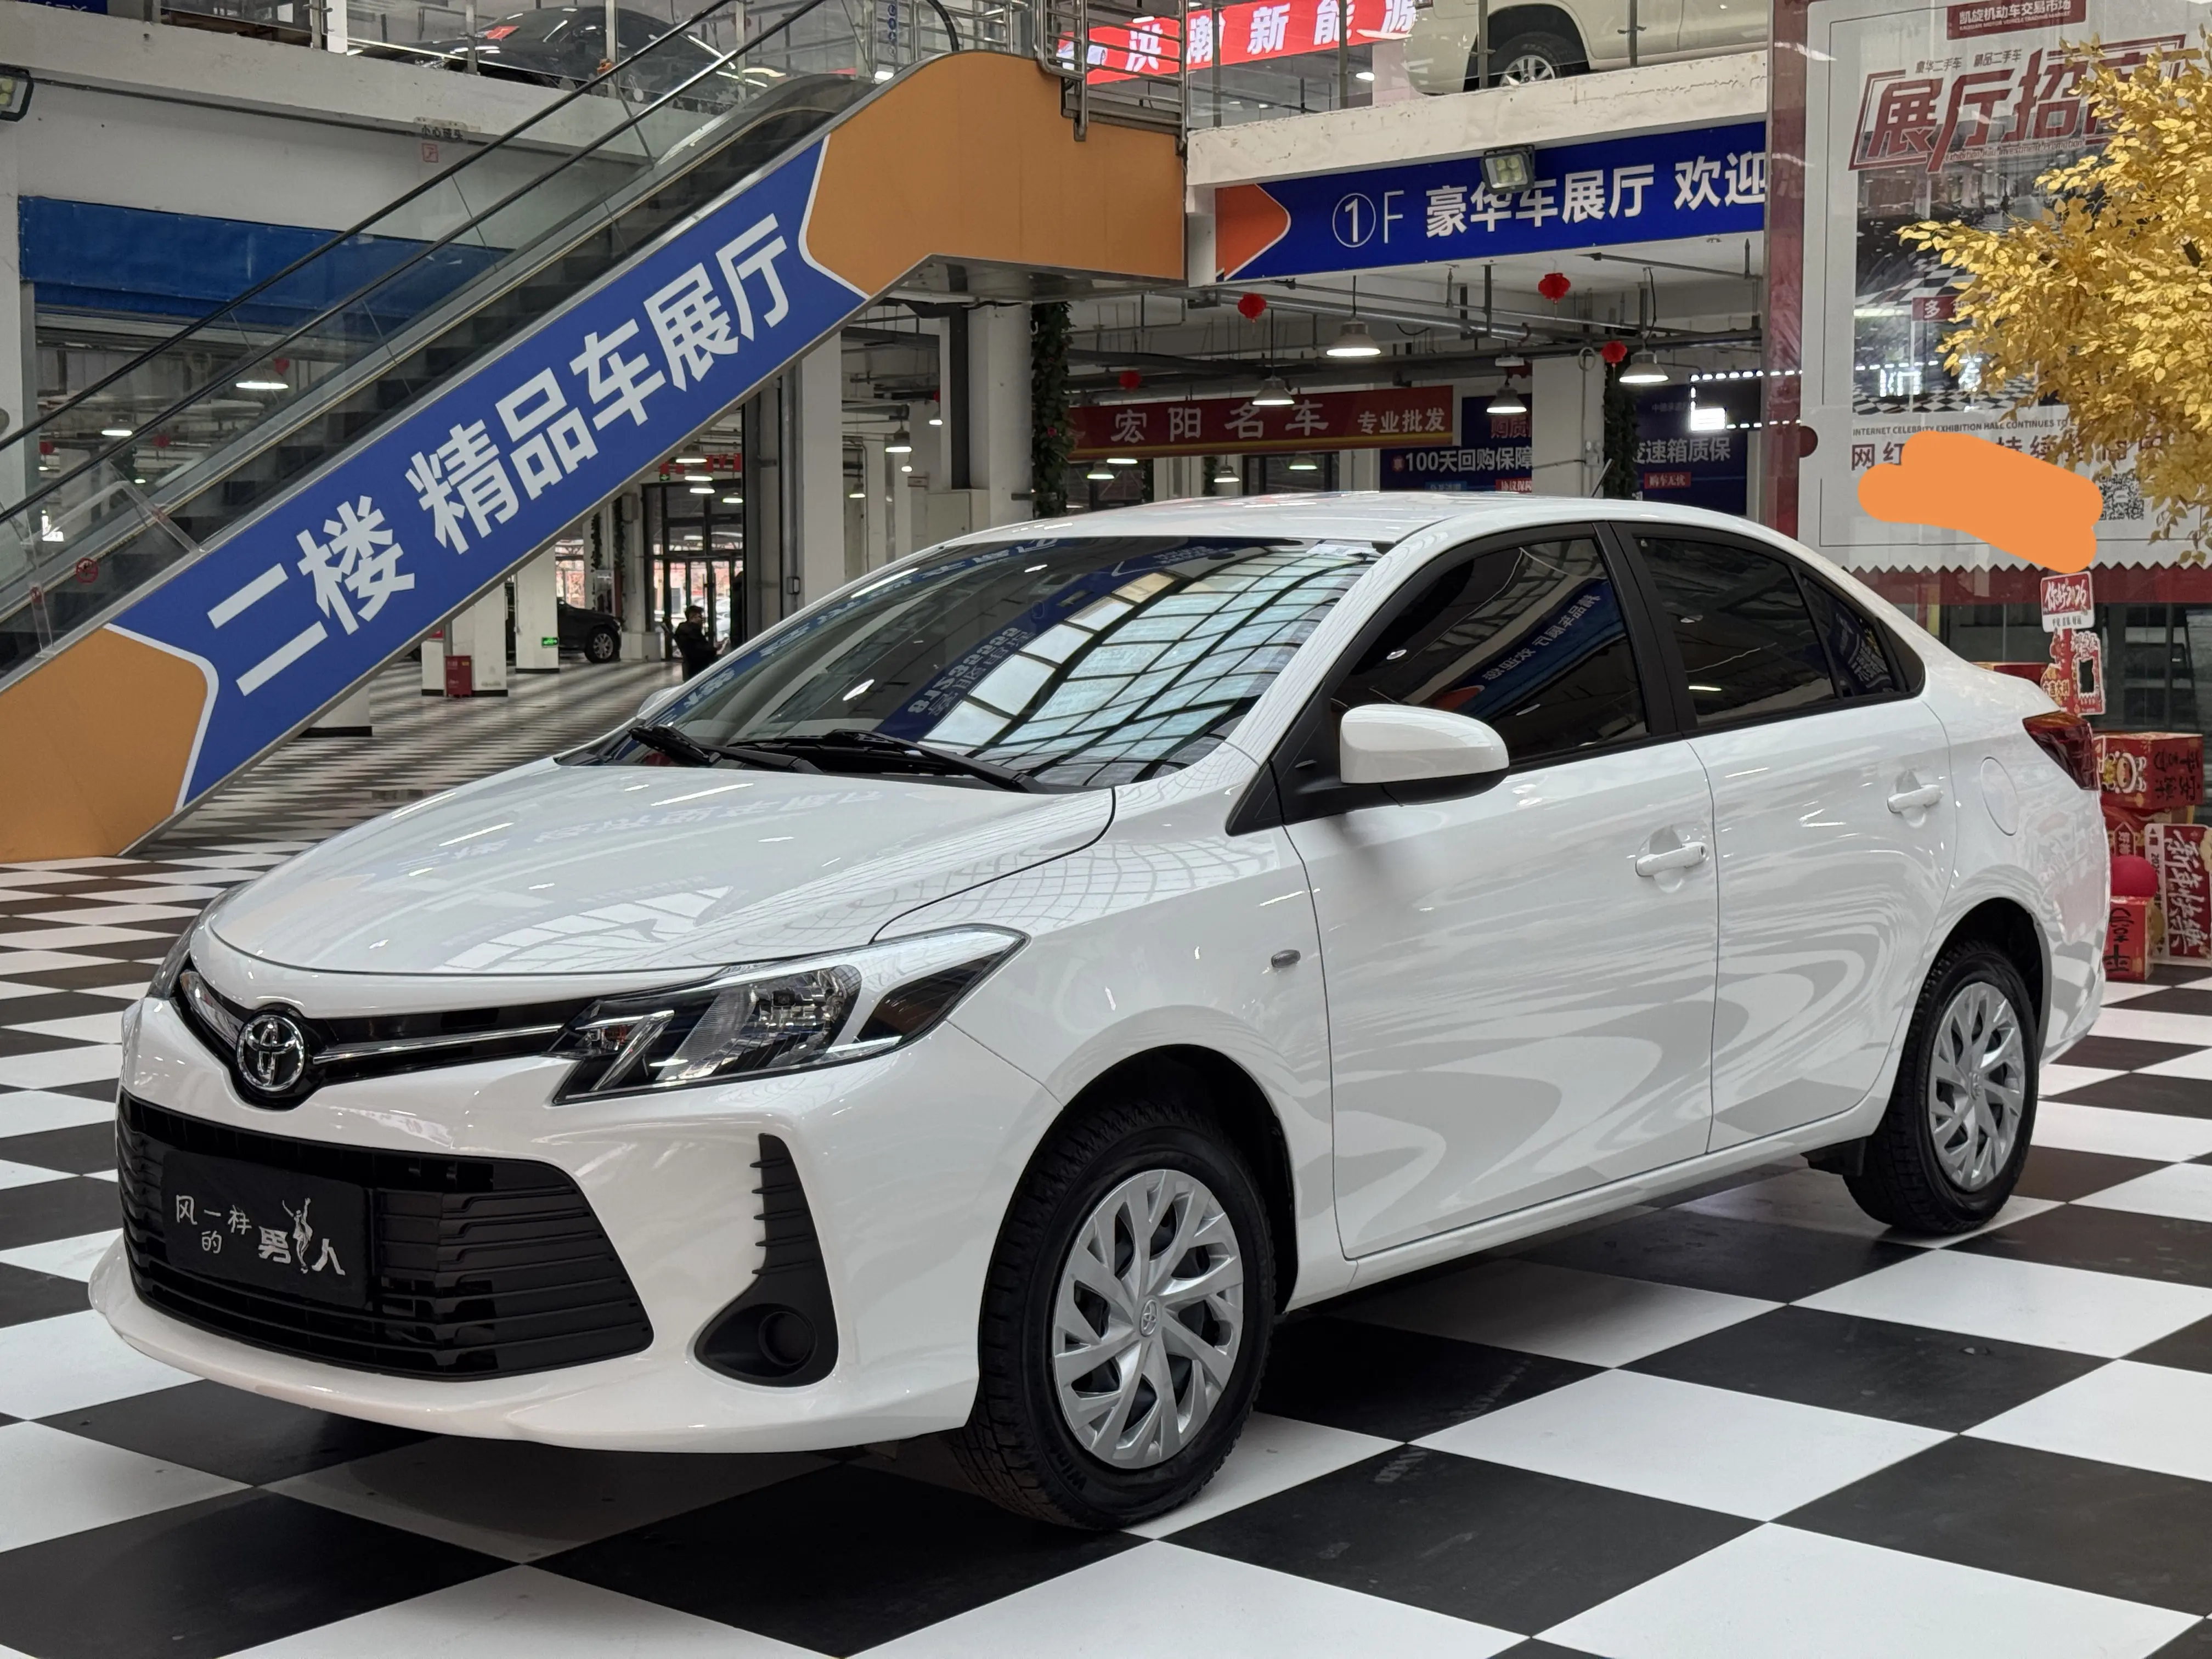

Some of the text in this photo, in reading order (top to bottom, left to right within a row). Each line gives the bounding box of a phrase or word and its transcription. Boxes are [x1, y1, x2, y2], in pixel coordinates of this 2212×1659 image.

[1959, 0, 2072, 24] 凯旋机动车交易市场
[1426, 163, 1655, 238] 豪华车展厅
[1674, 150, 1765, 211] 欢迎
[1110, 399, 1447, 444] 宏阳名车 专业批发
[1853, 427, 1891, 436] INTERNET
[1892, 424, 1935, 435] CELEBRITY
[1936, 422, 1982, 433] EXHIBITION
[2006, 419, 2055, 430] CONTINUES
[207, 213, 790, 696] 二楼 精品车展厅
[1406, 445, 1532, 473] 100天回购保障
[176, 1194, 253, 1235] 风一样
[201, 1226, 346, 1276] 的 男人
